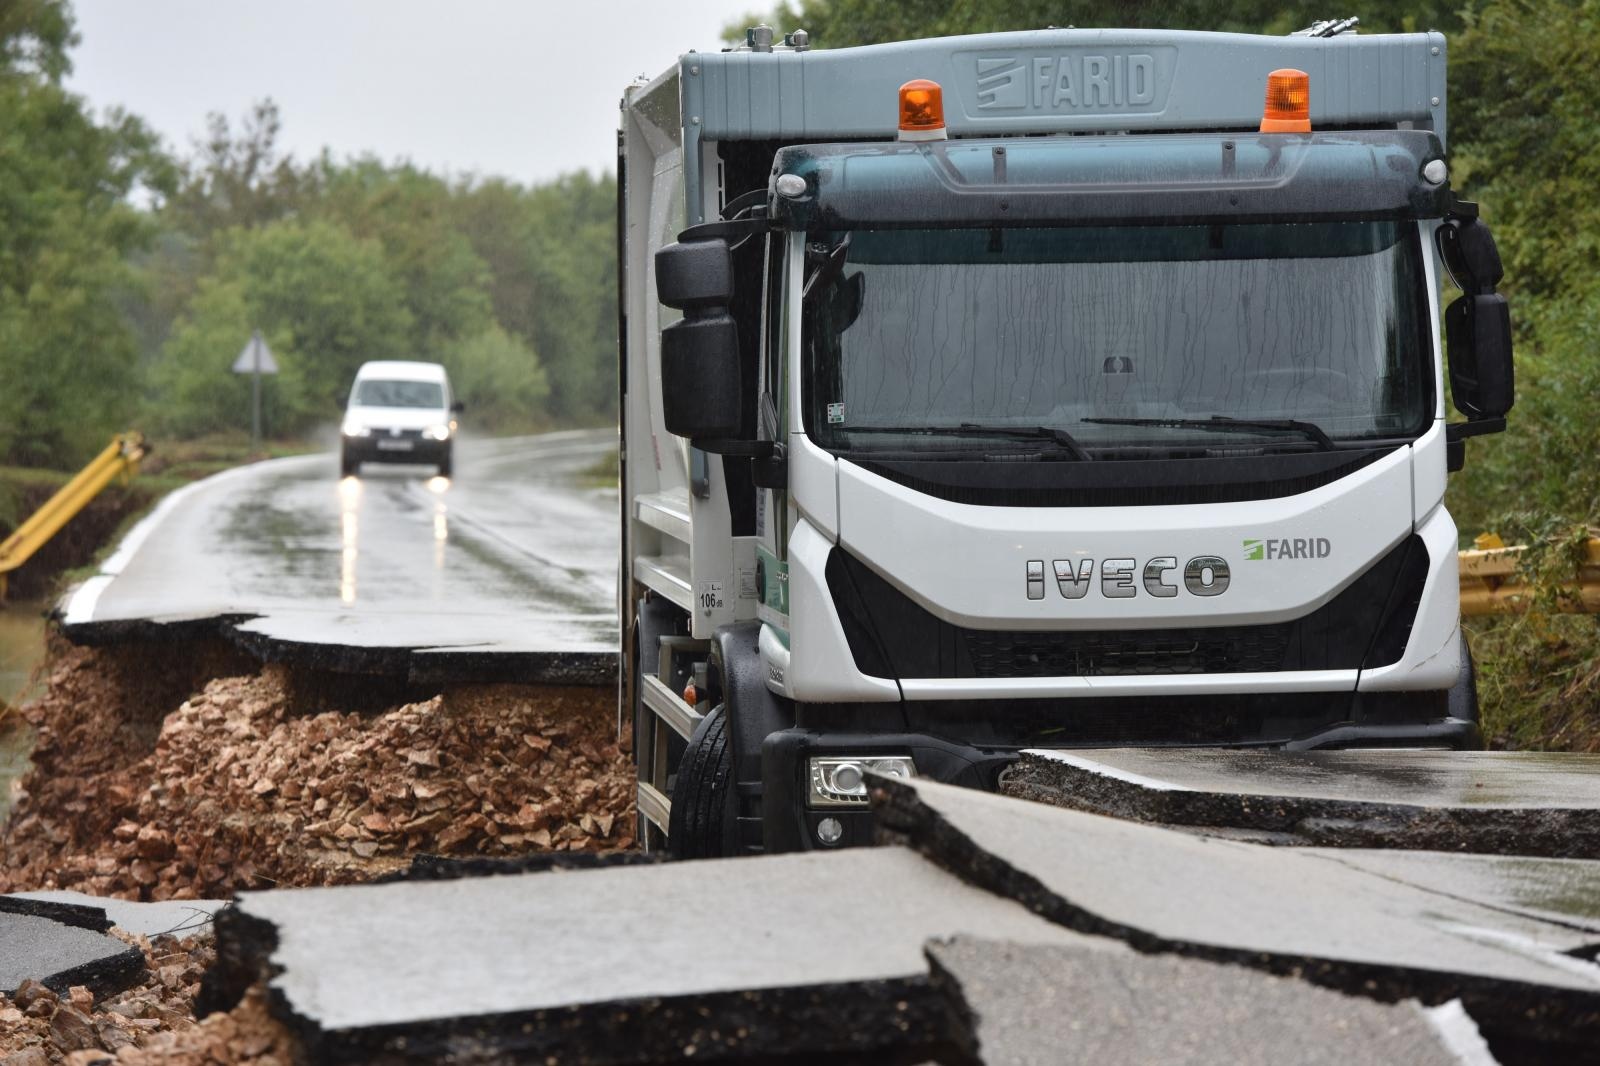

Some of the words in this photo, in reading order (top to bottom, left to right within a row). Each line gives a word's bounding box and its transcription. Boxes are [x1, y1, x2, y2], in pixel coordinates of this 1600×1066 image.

[1032, 54, 1154, 108] FARID
[1266, 537, 1332, 560] FARID
[1026, 555, 1232, 601] IVECO
[700, 593, 716, 608] 106
